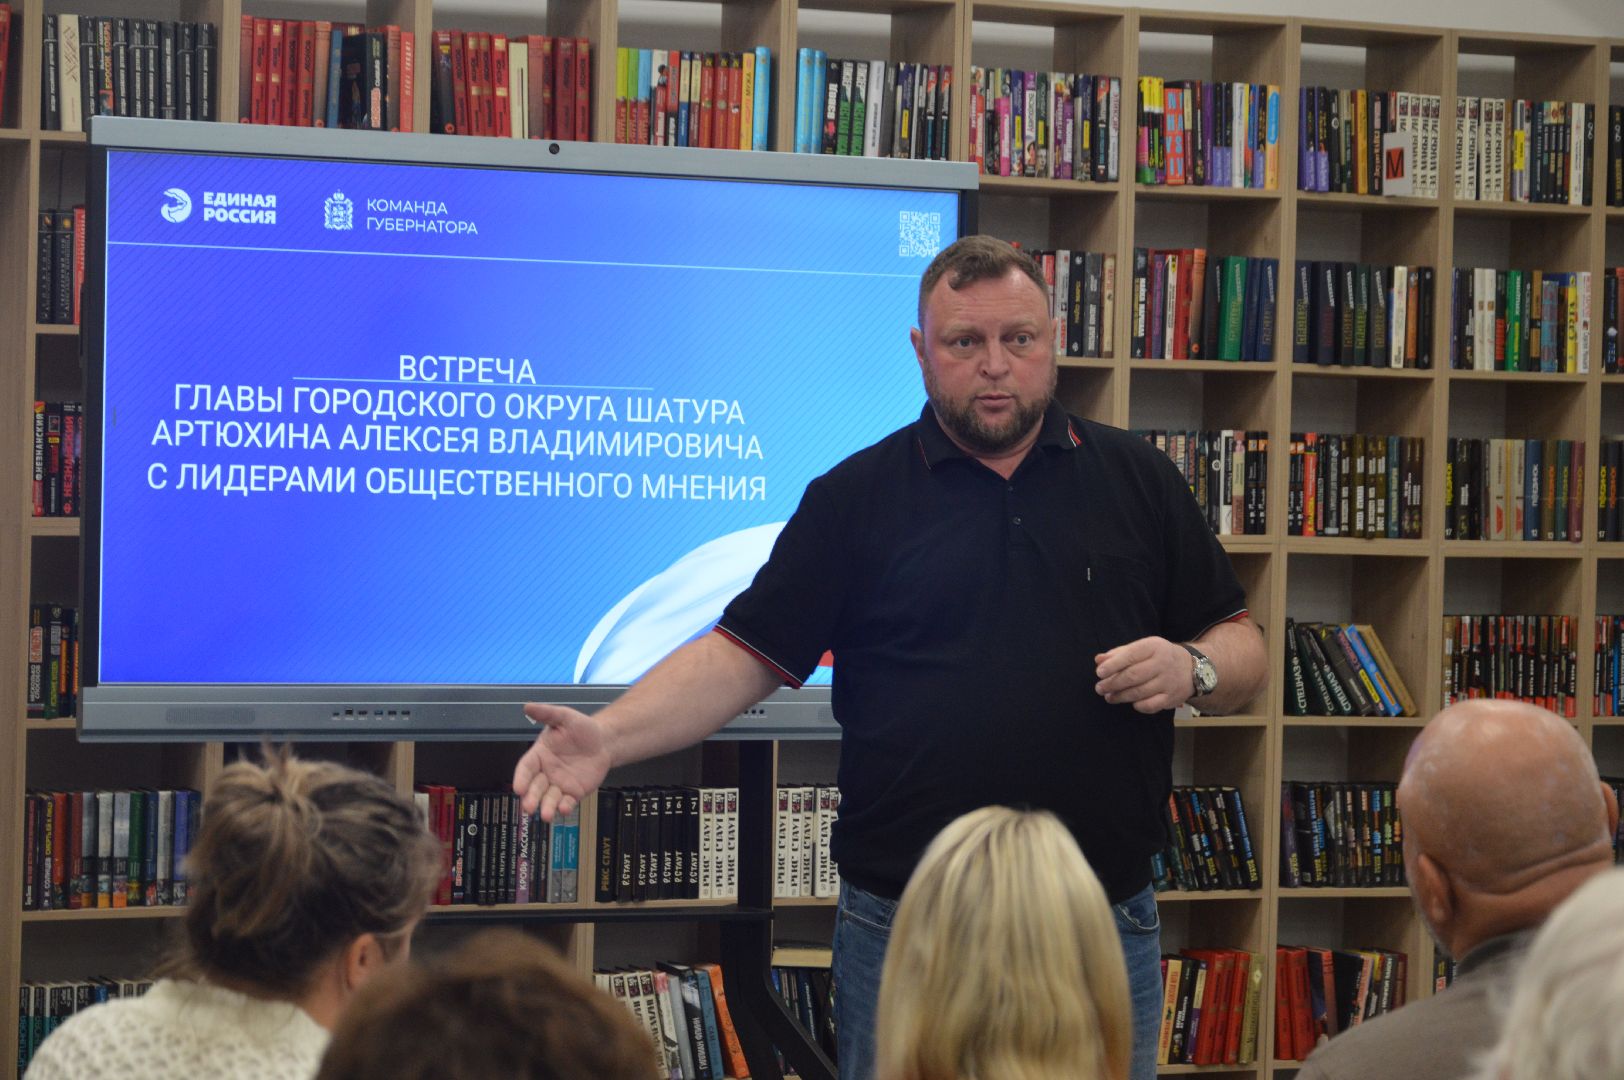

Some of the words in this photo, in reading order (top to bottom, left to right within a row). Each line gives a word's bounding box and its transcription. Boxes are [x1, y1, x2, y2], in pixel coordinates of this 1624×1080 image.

[204, 192, 276, 207] ЕДИНАЯ
[367, 198, 448, 215] КОМАНДА
[204, 208, 276, 225] РОССИЯ
[366, 216, 478, 235] ГУБЕРНАТОРА
[399, 355, 536, 384] ВСТРЕЧА
[175, 385, 283, 414] ГЛАВЫ
[293, 386, 496, 421] ГОРОДСКОГО
[504, 392, 617, 421] ОКРУГА
[626, 396, 744, 426] ШАТУРА
[152, 419, 330, 450] АРТЮХИНА
[340, 425, 479, 453] АЛЕКСЕЯ
[489, 428, 764, 460] ВЛАДИМИРОВИЧА
[147, 463, 167, 489] С
[177, 463, 356, 496] ЛИДЕРАМИ
[364, 468, 634, 501] ОБЩЕСТВЕННОГО
[643, 473, 767, 501] МНЕНИЯ
[1293, 665, 1307, 708] СПЕЦНАЗ
[1327, 672, 1351, 711] СПЕЦНАЗ
[602, 836, 611, 866] СТАУТ
[601, 868, 610, 891] РЕКС
